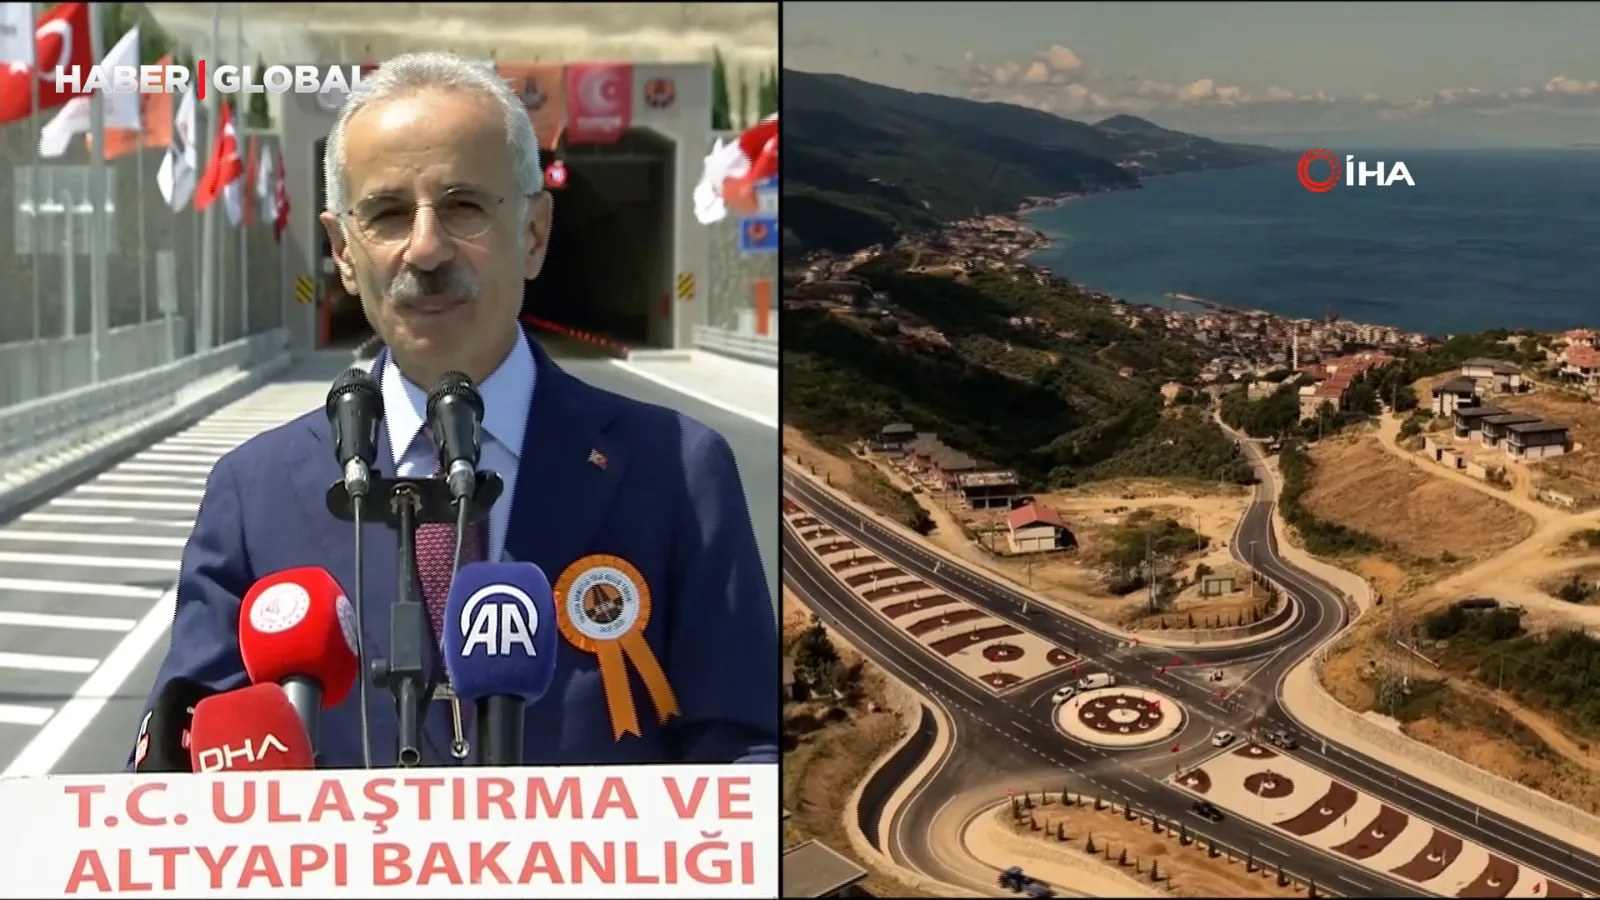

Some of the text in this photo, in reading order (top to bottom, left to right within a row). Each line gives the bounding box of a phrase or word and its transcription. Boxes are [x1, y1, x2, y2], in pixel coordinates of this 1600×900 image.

[460, 602, 538, 657] AA
[198, 733, 289, 773] DHA
[65, 776, 753, 833] T.C. ULAŞTIRMA VE
[64, 832, 755, 894] ALTYAPI BAKANLIĞI
